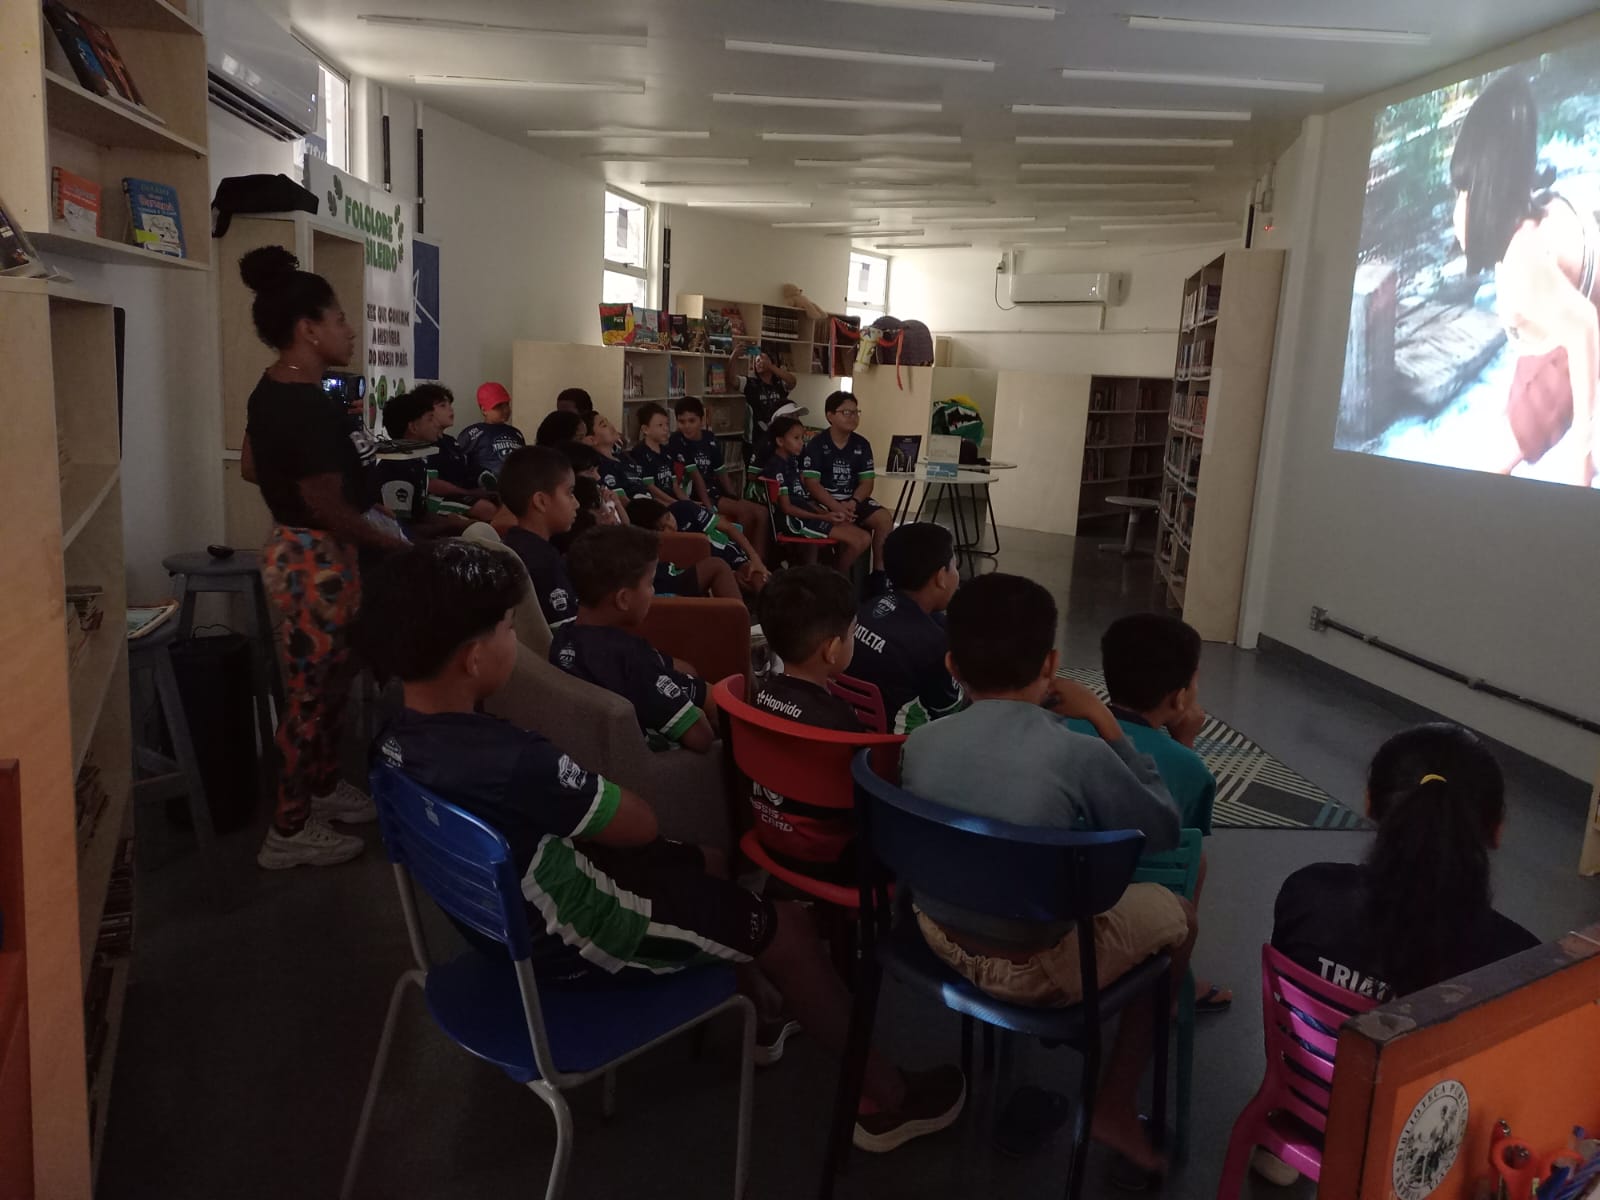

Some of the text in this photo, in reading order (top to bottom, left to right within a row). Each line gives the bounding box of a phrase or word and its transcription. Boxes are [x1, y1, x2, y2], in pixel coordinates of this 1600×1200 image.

[345, 195, 393, 243] FOLCLORE
[366, 237, 397, 273] SILEIRO
[855, 623, 886, 654] ATLETA
[763, 693, 803, 719] Hapvida
